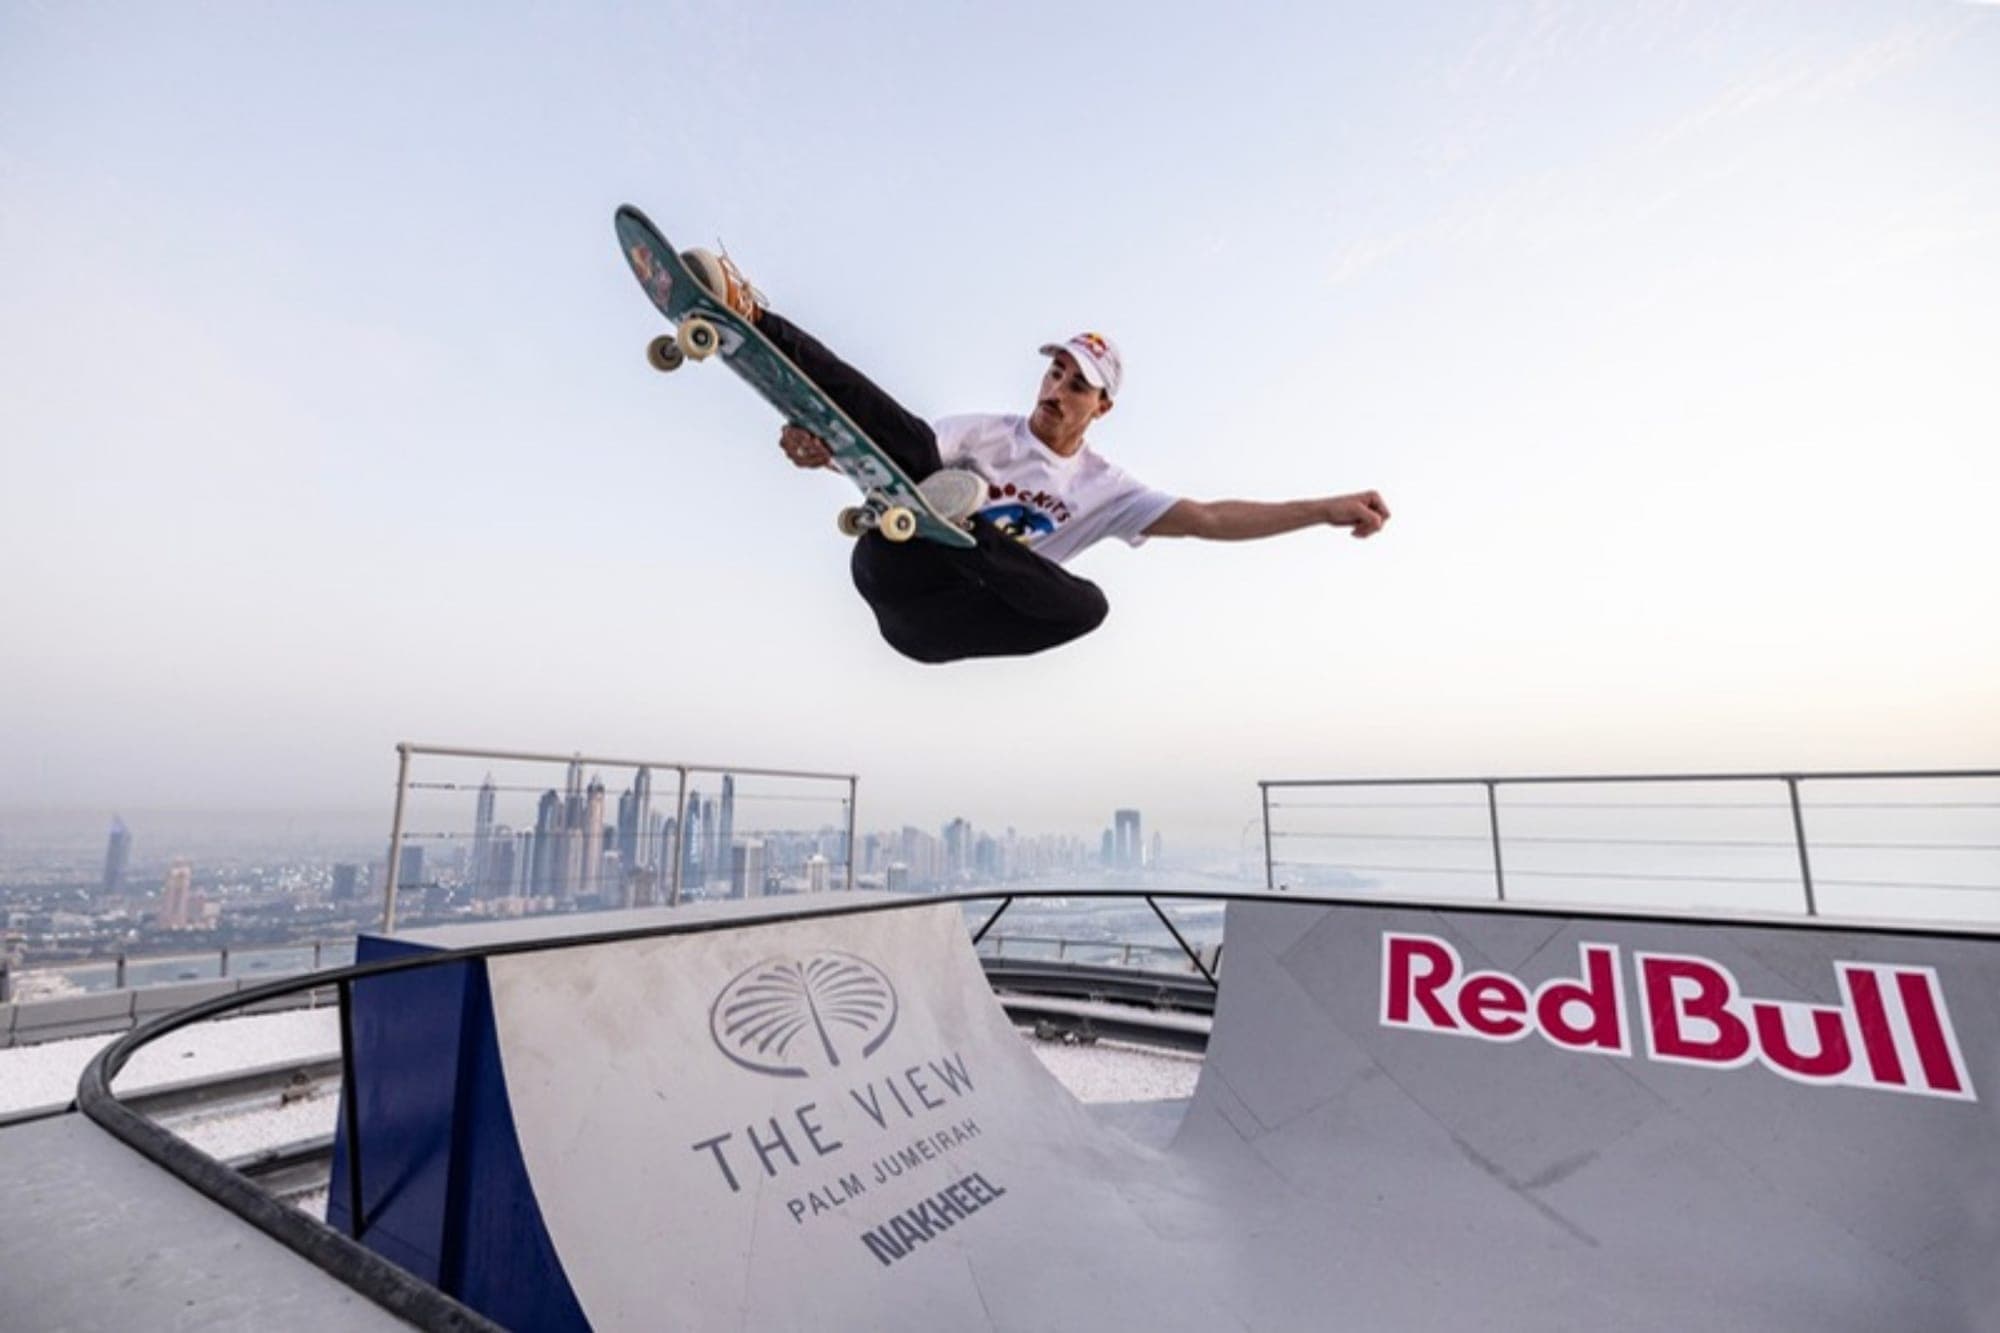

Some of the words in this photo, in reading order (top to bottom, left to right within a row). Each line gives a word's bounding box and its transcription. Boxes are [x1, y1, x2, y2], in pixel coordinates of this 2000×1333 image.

[1387, 937, 1622, 1050] Red
[1642, 956, 1964, 1093] Bull
[691, 1102, 843, 1193] THE
[849, 1052, 974, 1130] VIEW
[786, 1172, 866, 1224] PALM
[872, 1117, 982, 1184] JUMEIRAH
[860, 1172, 1007, 1267] NAKHEEL
